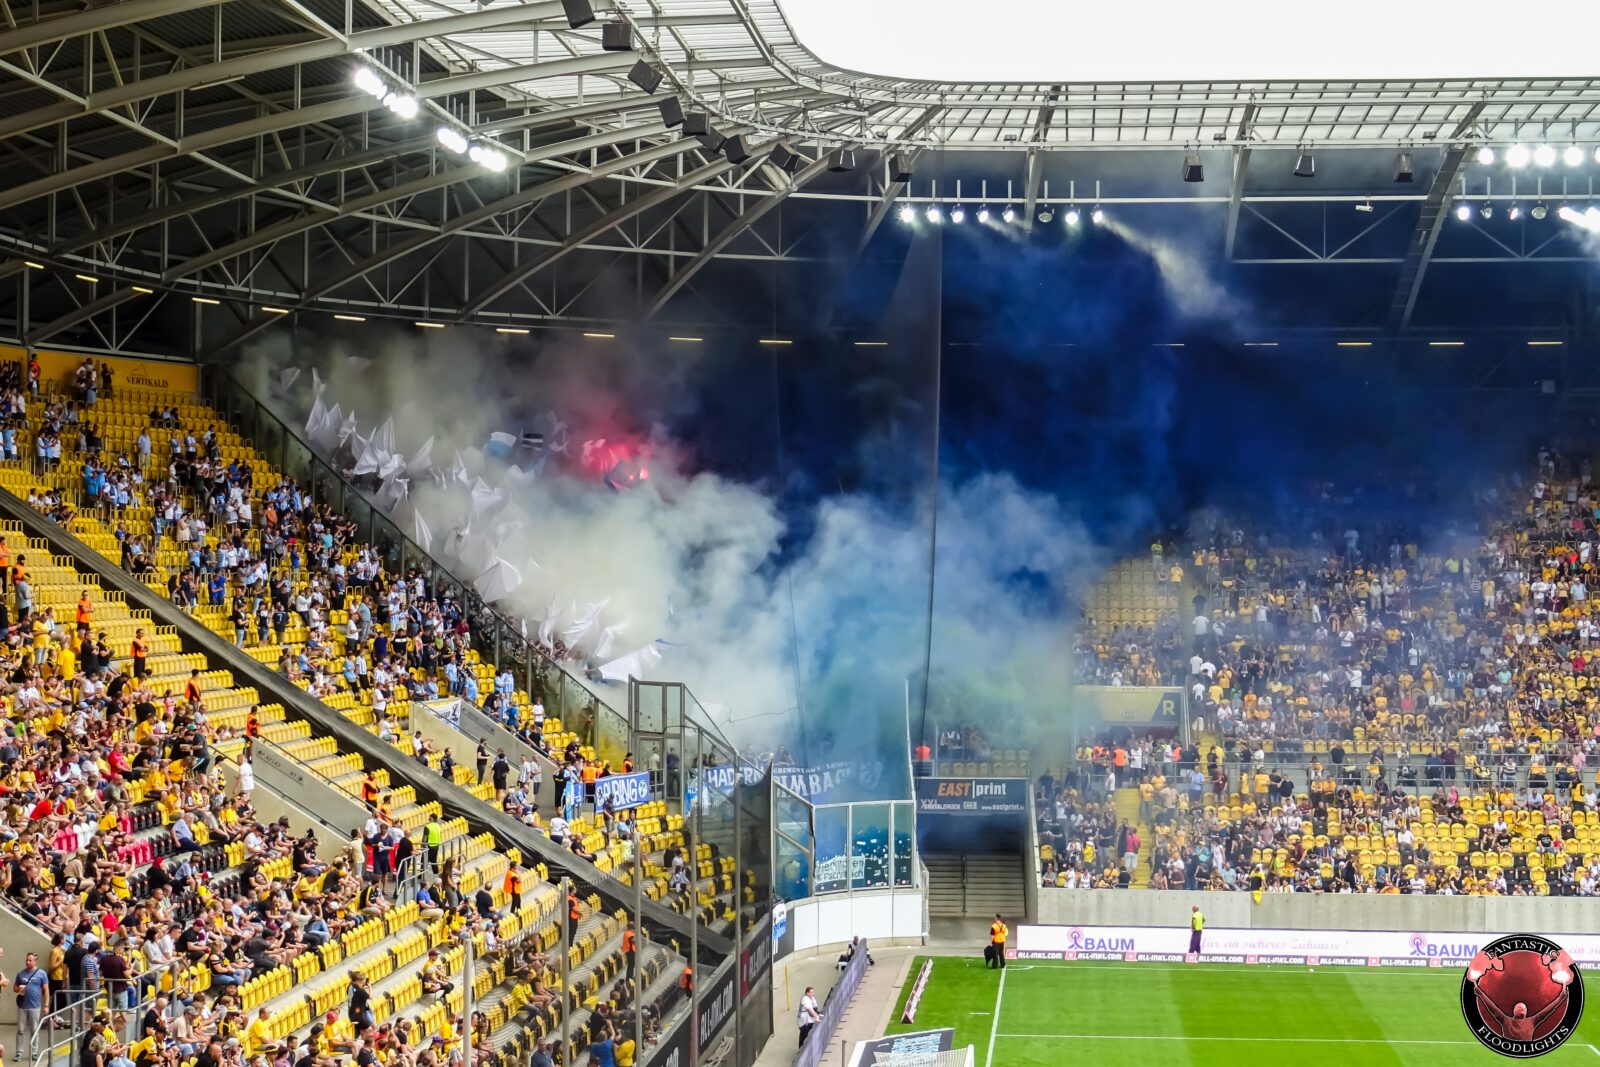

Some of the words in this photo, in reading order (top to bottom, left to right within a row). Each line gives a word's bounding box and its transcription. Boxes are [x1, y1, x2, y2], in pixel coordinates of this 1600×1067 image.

[126, 376, 169, 388] VERTIKALIS
[1162, 699, 1176, 716] R
[707, 766, 765, 788] HADRN
[937, 782, 971, 797] EAST
[976, 782, 1007, 797] print
[1084, 938, 1135, 951] BAUM
[1427, 944, 1478, 957] BAUM
[700, 979, 733, 1047] ALL-INKL.COM
